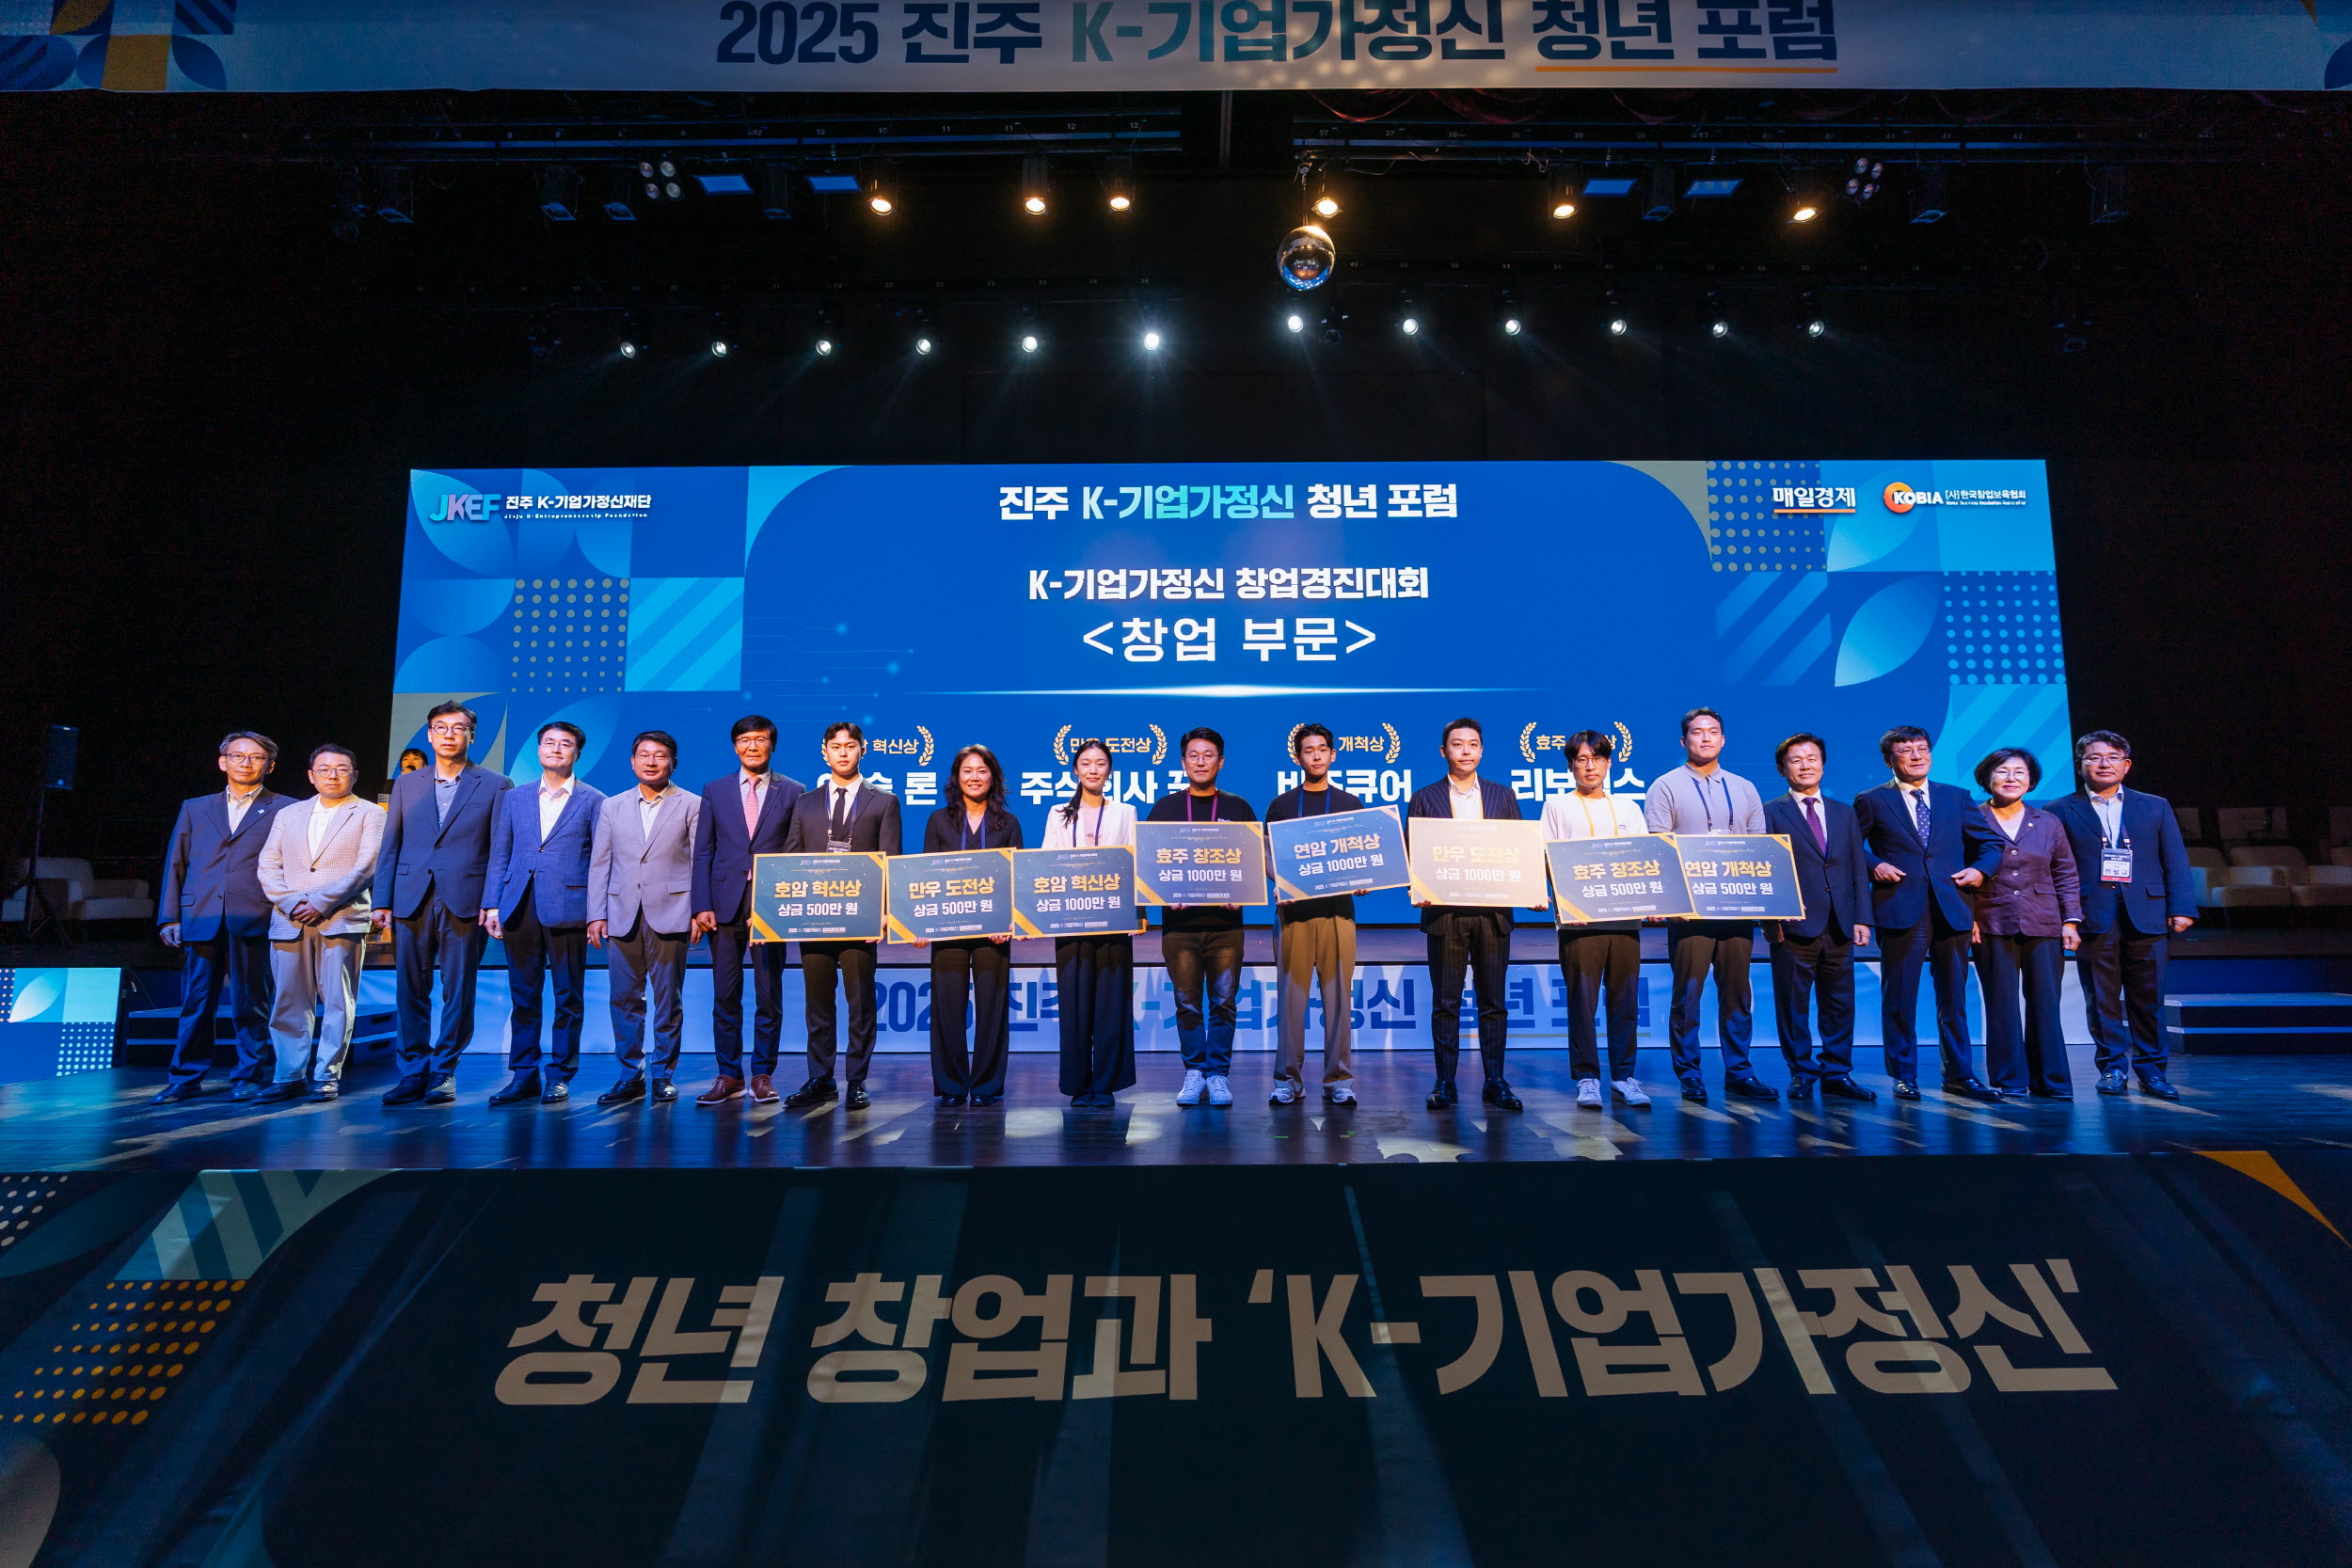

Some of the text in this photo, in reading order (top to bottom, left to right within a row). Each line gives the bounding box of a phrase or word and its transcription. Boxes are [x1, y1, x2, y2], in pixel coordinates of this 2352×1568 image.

[717, 0, 1837, 64] 2025 진주 K-기업가정신 청년 포럼
[505, 494, 652, 509] 진주 K-기업가정신재단
[999, 484, 1458, 520] 진주 K-기업가정신 청년 포럼
[1772, 487, 1856, 508] 매일경제
[1893, 491, 1944, 505] KOBIA
[430, 493, 501, 521] JKEF
[1028, 567, 1429, 600] K-기업가정신 창업경진대회
[1083, 617, 1376, 662] <창업 부문>
[872, 738, 919, 754] 혁신상
[1104, 737, 1152, 753] 도전상
[1338, 736, 1385, 752] 개척상
[1535, 735, 1566, 751] 효주
[1511, 768, 1646, 801] 리보스
[1155, 847, 1242, 864] 효주 창조상
[1294, 833, 1380, 860] 연암 개척상
[1433, 846, 1520, 864] 만우 도전상
[1298, 853, 1384, 877] 상금 1000만 원
[1573, 860, 1661, 880] 효주 창조상
[1685, 861, 1772, 878] 연암 개척상
[1158, 869, 1242, 882] 상금 1000만 원
[1435, 867, 1521, 882] 상금 1000만 원
[774, 879, 862, 898] 호암 혁신상
[908, 877, 995, 900] 만우 도전상
[1033, 873, 1120, 895] 호암 혁신상
[1581, 880, 1664, 898] 상금 500만 원
[1692, 882, 1773, 895] 상금 500만 원
[778, 901, 858, 916] 상금 500만 원
[914, 899, 993, 918] 상금 500만 원
[1036, 895, 1120, 912] 상금 1000만 원
[494, 1275, 785, 1406] 청년
[806, 1272, 1213, 1403] 창업과
